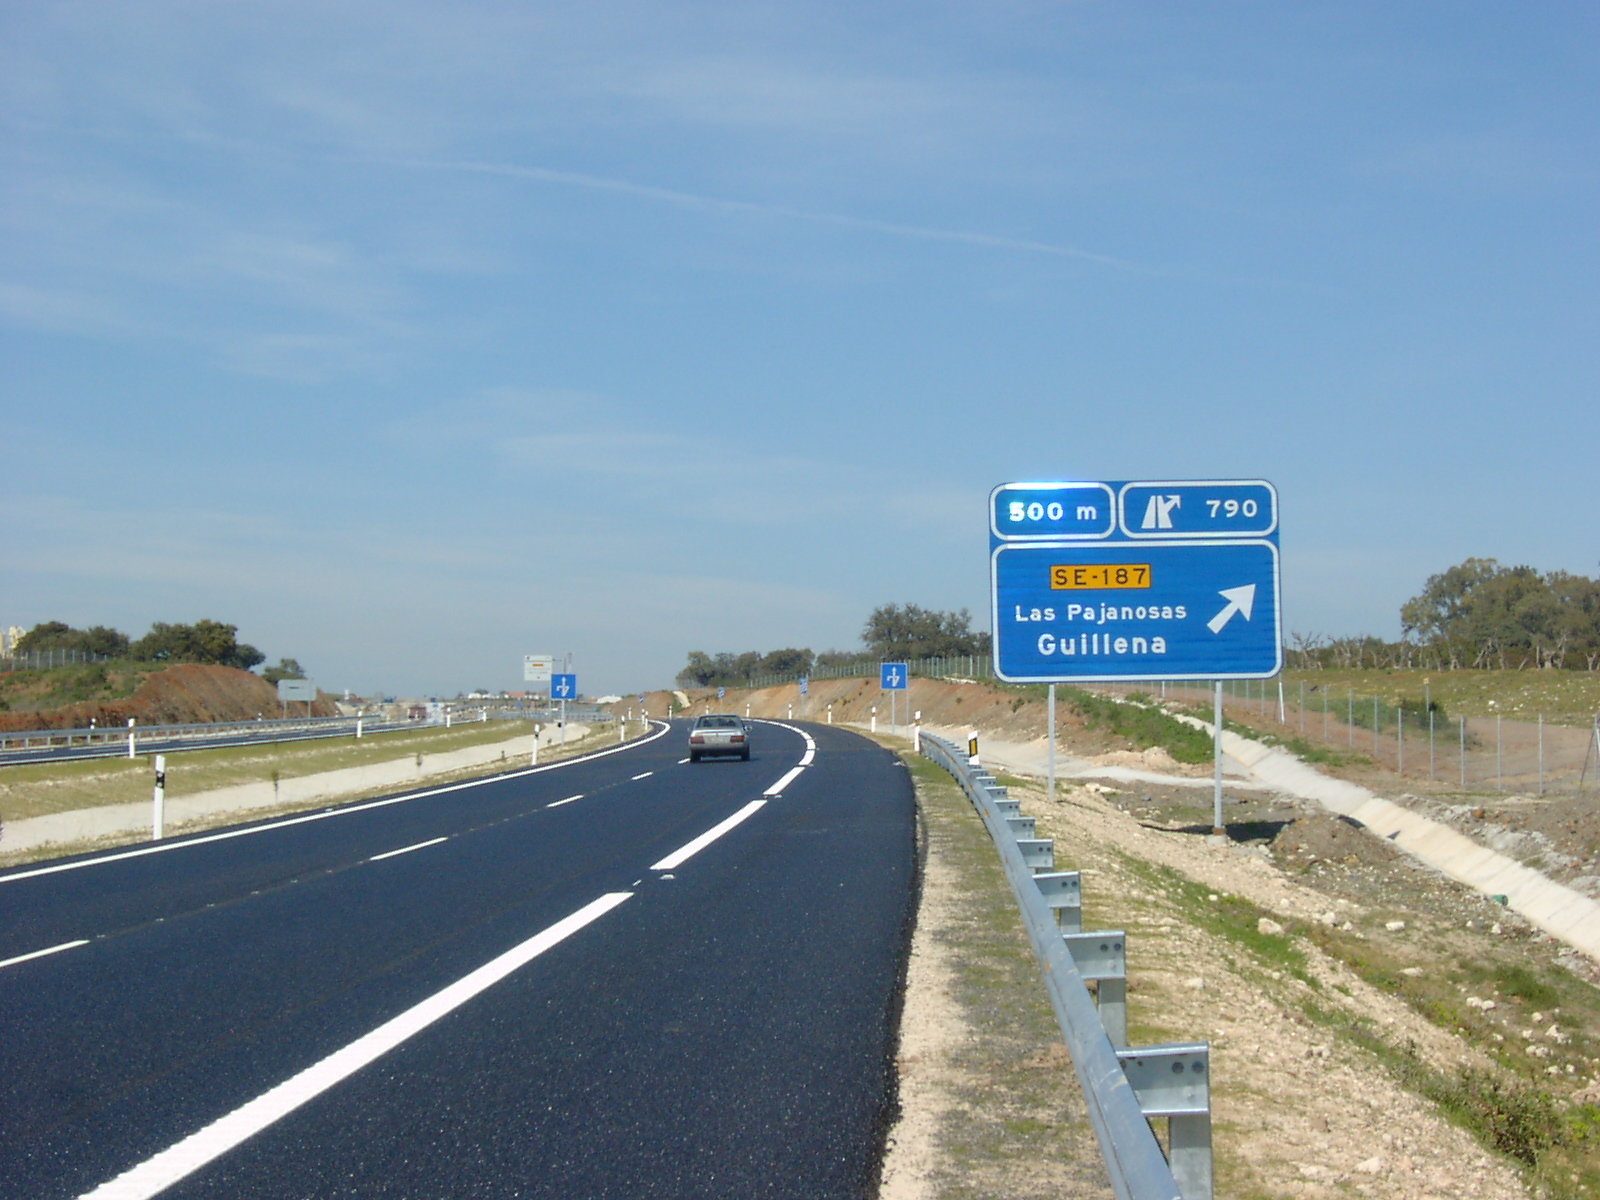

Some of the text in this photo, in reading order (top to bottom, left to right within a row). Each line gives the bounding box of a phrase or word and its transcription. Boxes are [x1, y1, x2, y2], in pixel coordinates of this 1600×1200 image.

[1008, 502, 1097, 522] 500 m
[1206, 499, 1258, 518] 790
[1055, 567, 1147, 586] SE-187
[1015, 602, 1187, 625] Las Pajanosas
[1037, 633, 1167, 656] Guillena
